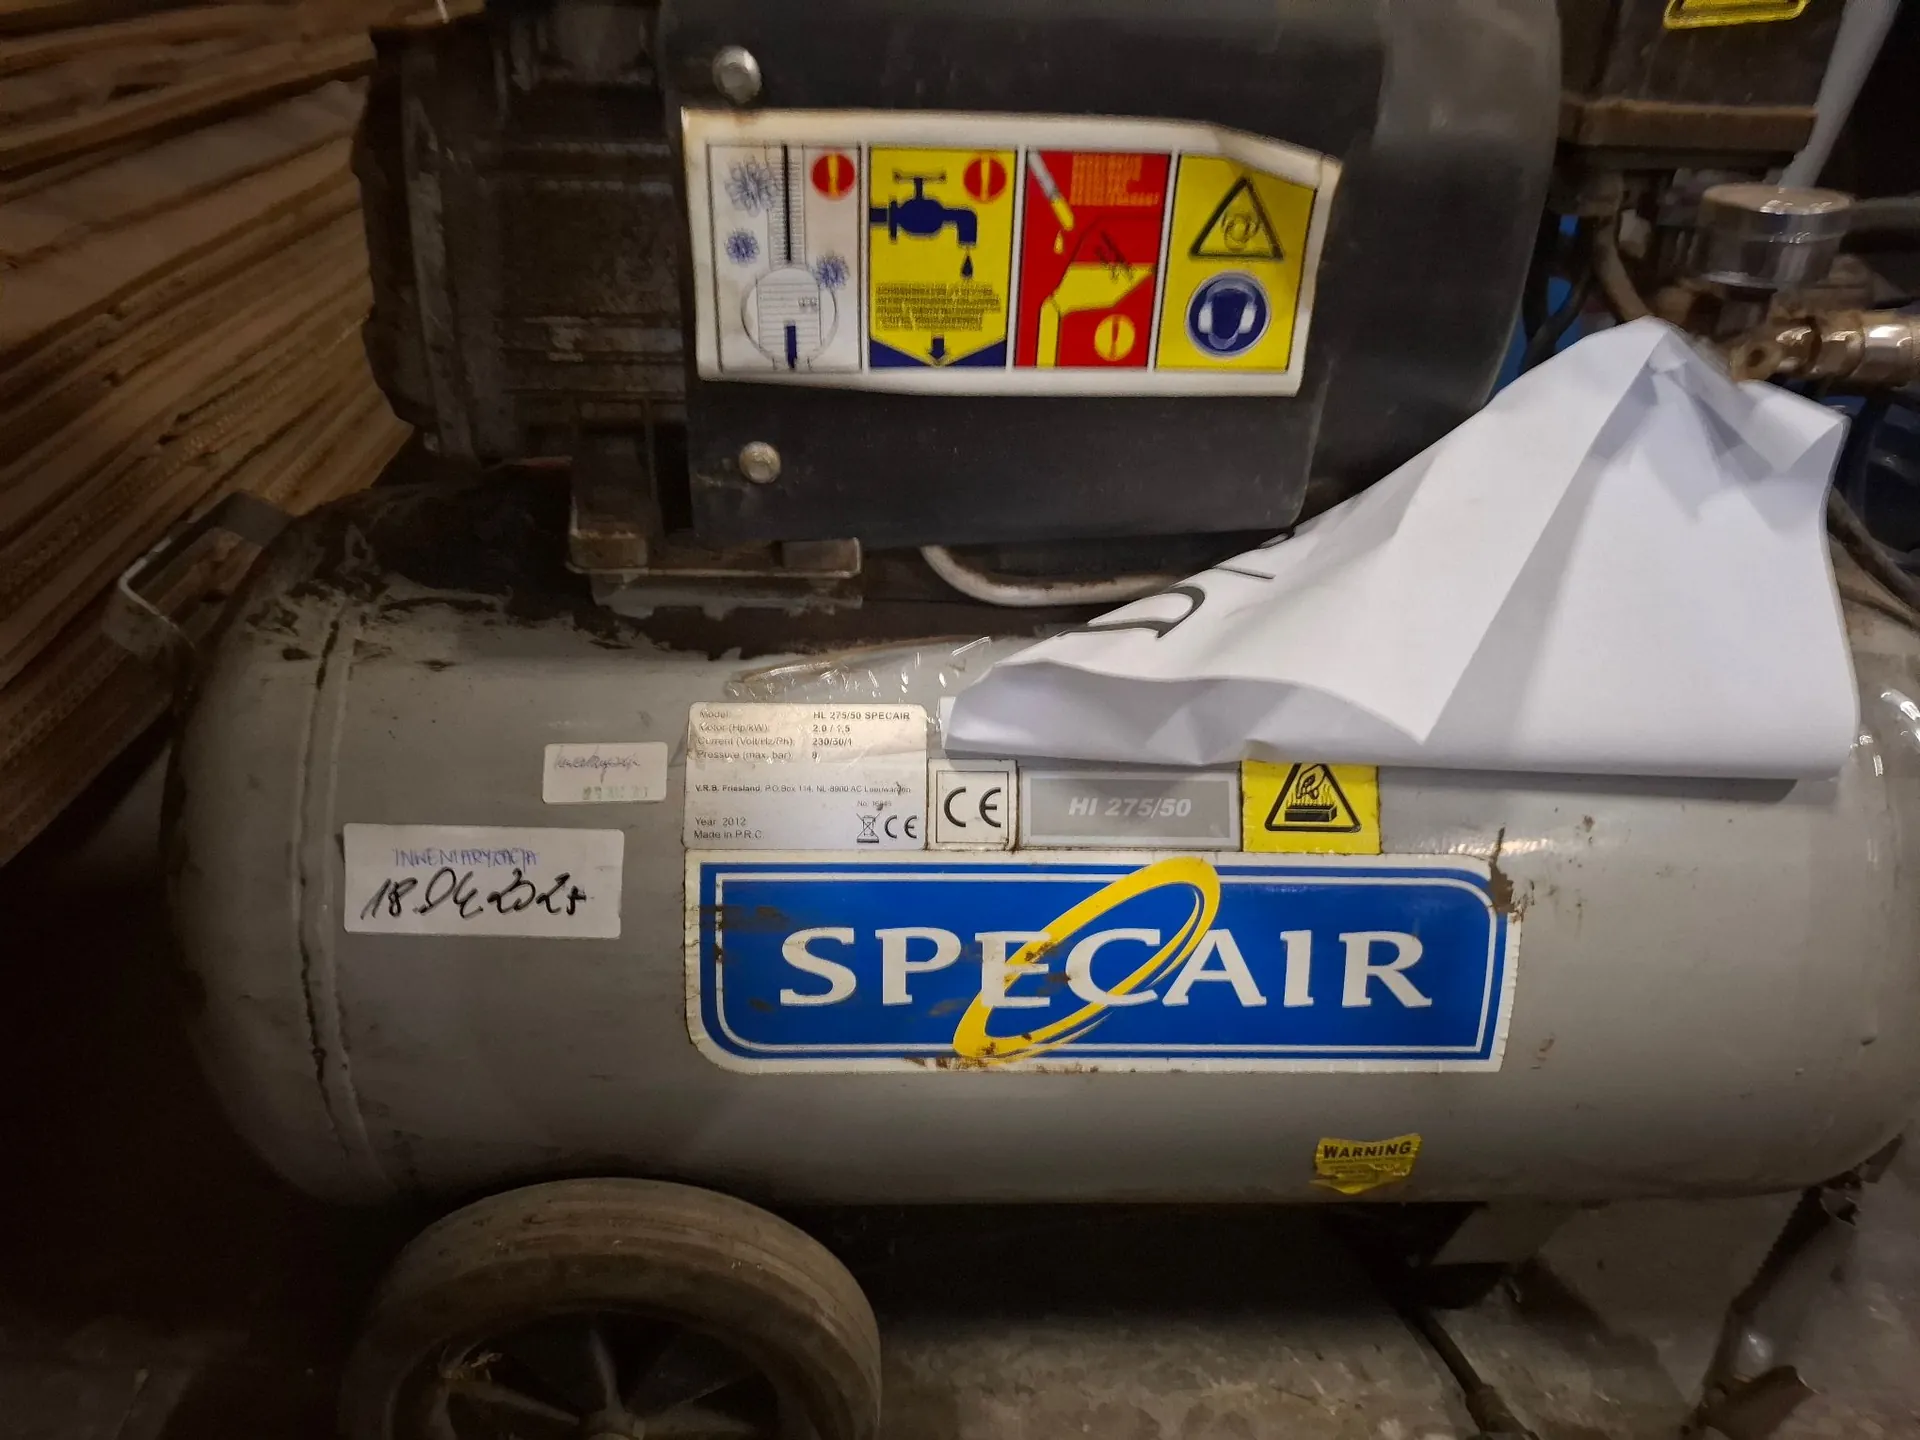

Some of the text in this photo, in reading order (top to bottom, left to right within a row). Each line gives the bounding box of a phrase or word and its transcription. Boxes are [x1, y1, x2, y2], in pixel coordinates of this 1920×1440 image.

[813, 711, 911, 720] HL 275/50 SPECAIR
[943, 786, 1001, 829] CE
[1067, 797, 1193, 819] HI 275/50
[722, 816, 747, 827] 2012
[693, 830, 721, 839] Made
[723, 830, 733, 839] in
[779, 926, 1433, 1009] SPECAIR
[1323, 1140, 1412, 1159] WARNING
